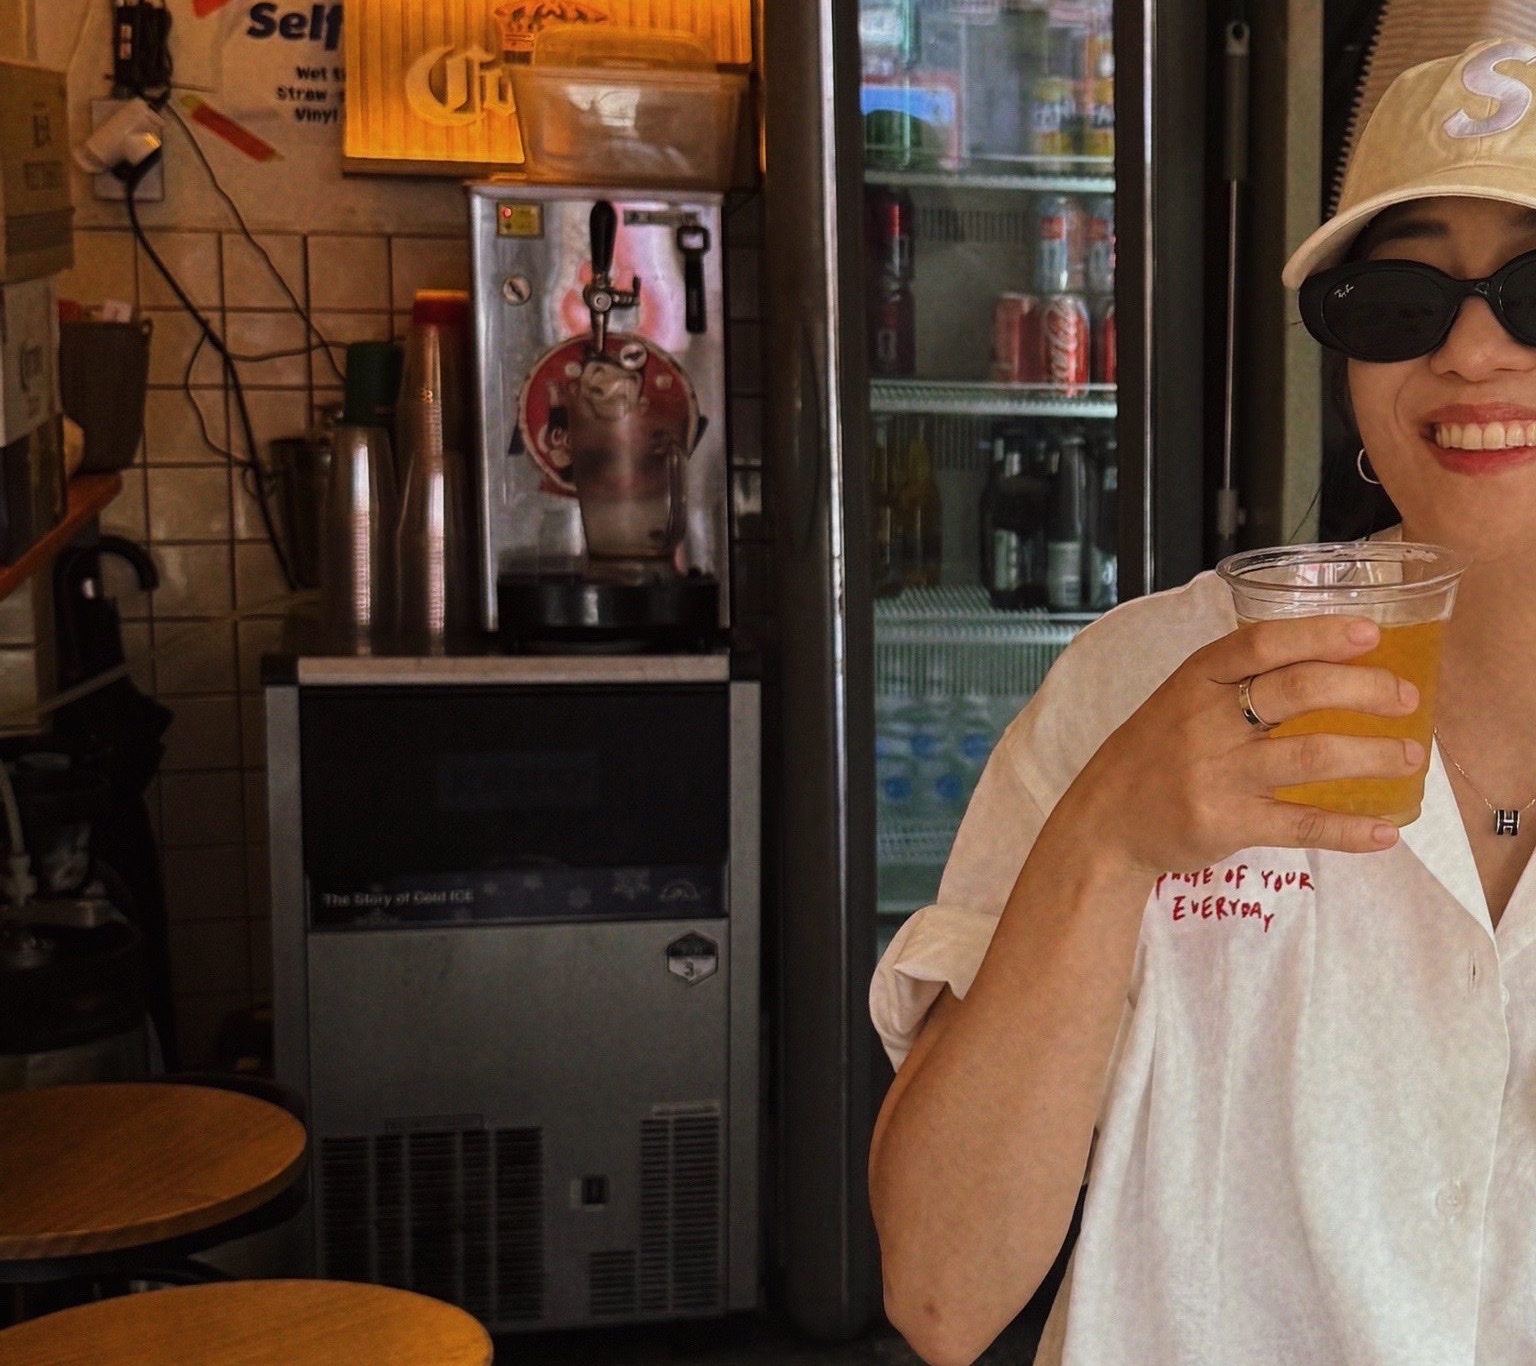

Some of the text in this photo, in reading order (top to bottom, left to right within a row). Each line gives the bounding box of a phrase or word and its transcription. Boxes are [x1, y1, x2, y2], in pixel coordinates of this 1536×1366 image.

[295, 64, 328, 82] Wet
[295, 107, 339, 125] Vinyl
[1224, 864, 1249, 889] OF
[1261, 869, 1315, 893] YOUR
[323, 892, 351, 908] The
[353, 892, 392, 908] Story
[395, 891, 410, 905] of
[449, 887, 475, 904] ICE
[1172, 894, 1275, 933] EVERYDAY
